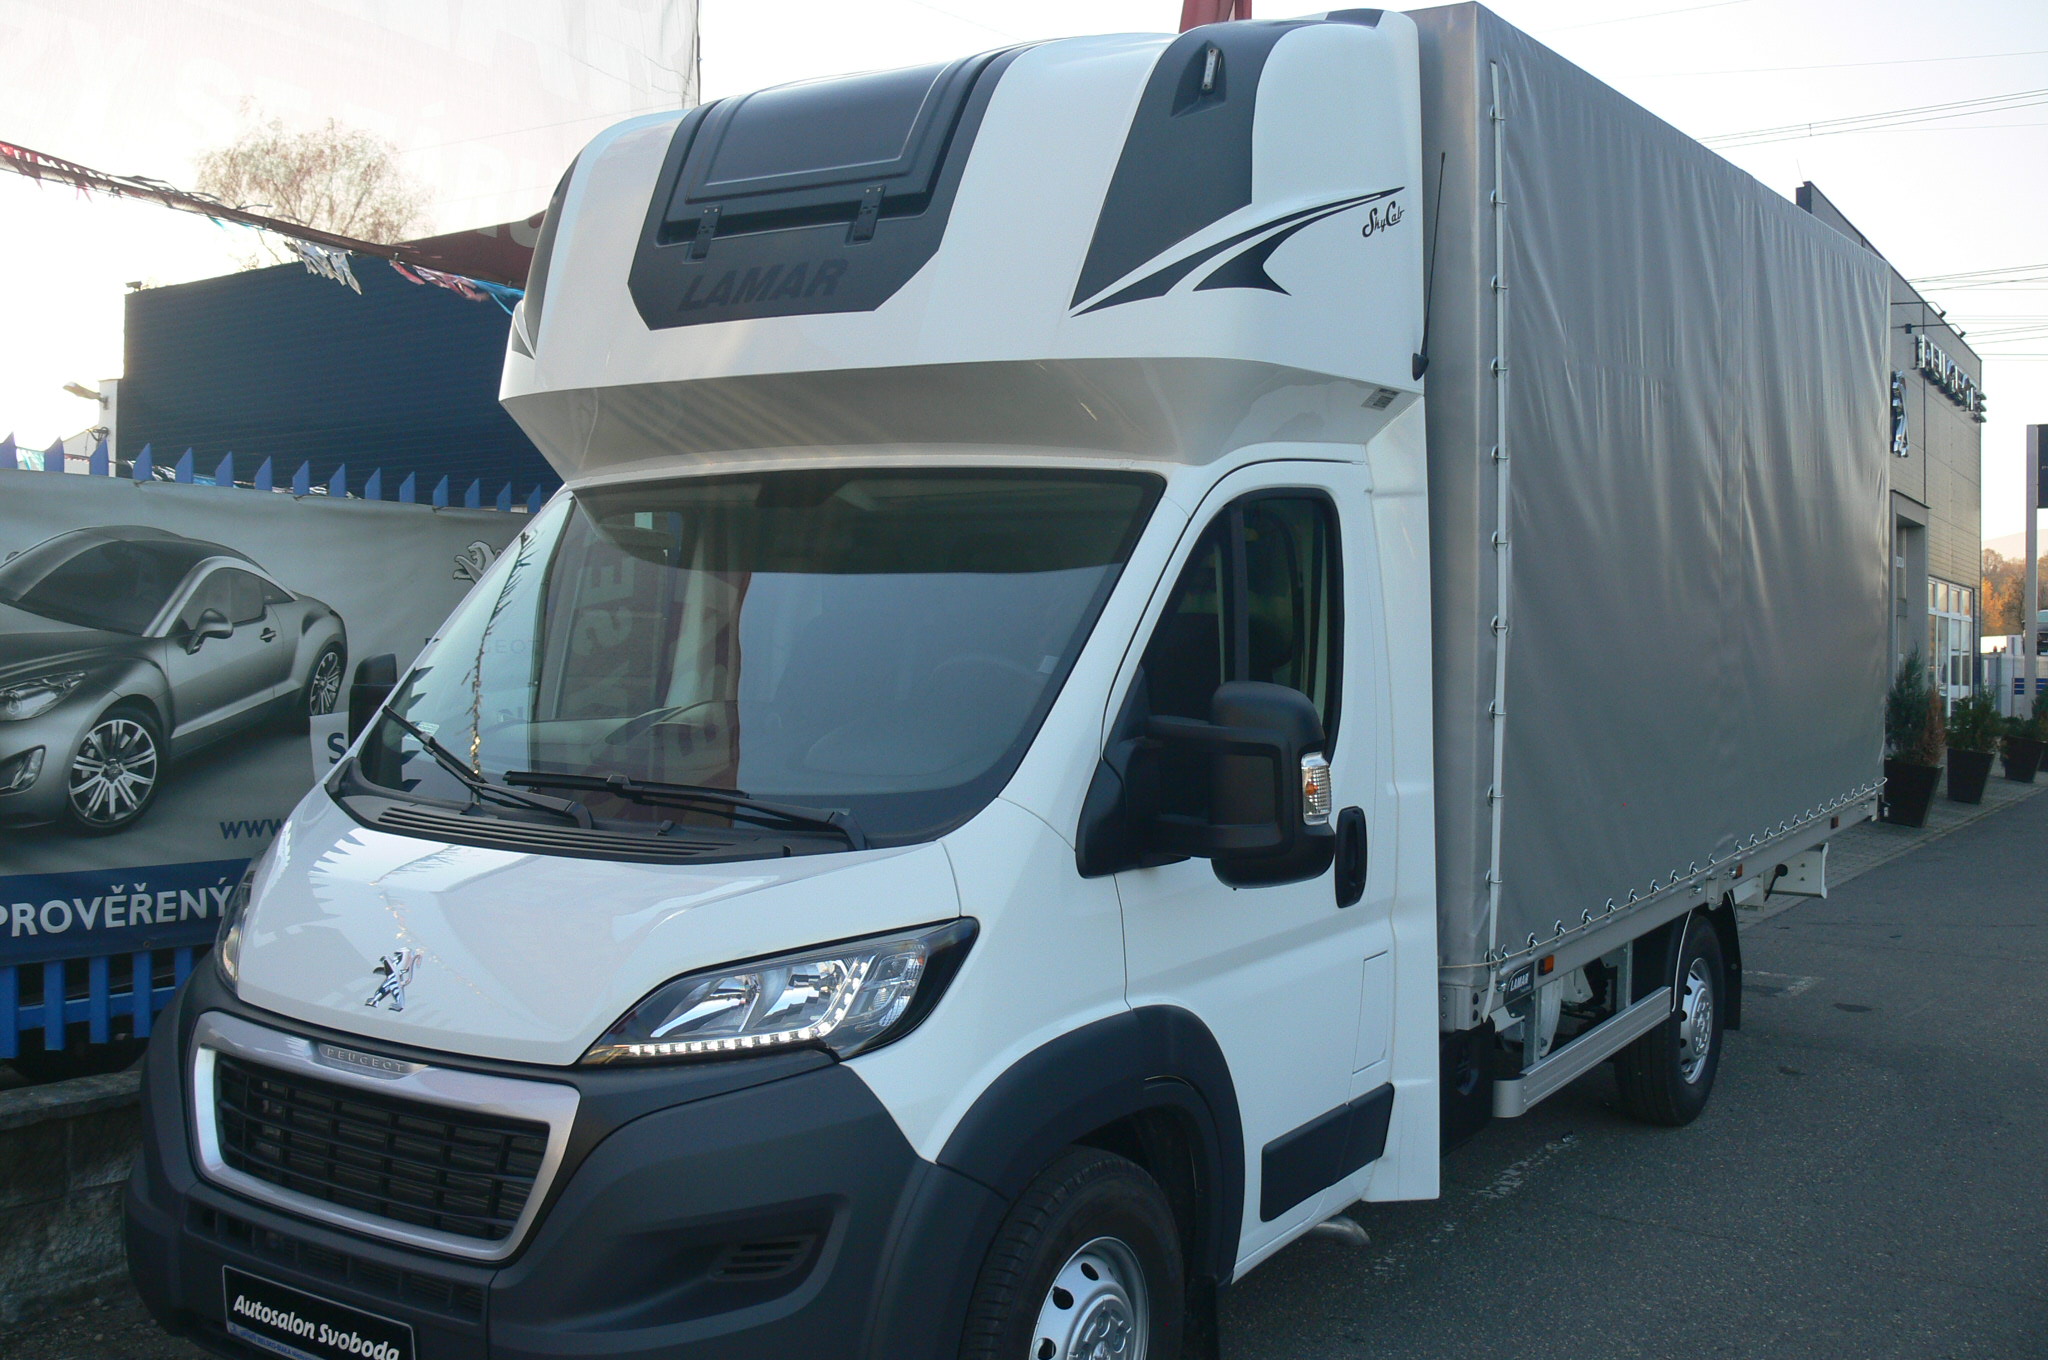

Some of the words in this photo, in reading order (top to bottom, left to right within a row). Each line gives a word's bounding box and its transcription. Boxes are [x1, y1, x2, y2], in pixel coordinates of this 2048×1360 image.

[677, 257, 850, 311] LAMAR
[326, 1047, 405, 1072] PEUGEOT
[233, 1294, 315, 1340] Autosalon
[317, 1323, 400, 1360] Svoboda
